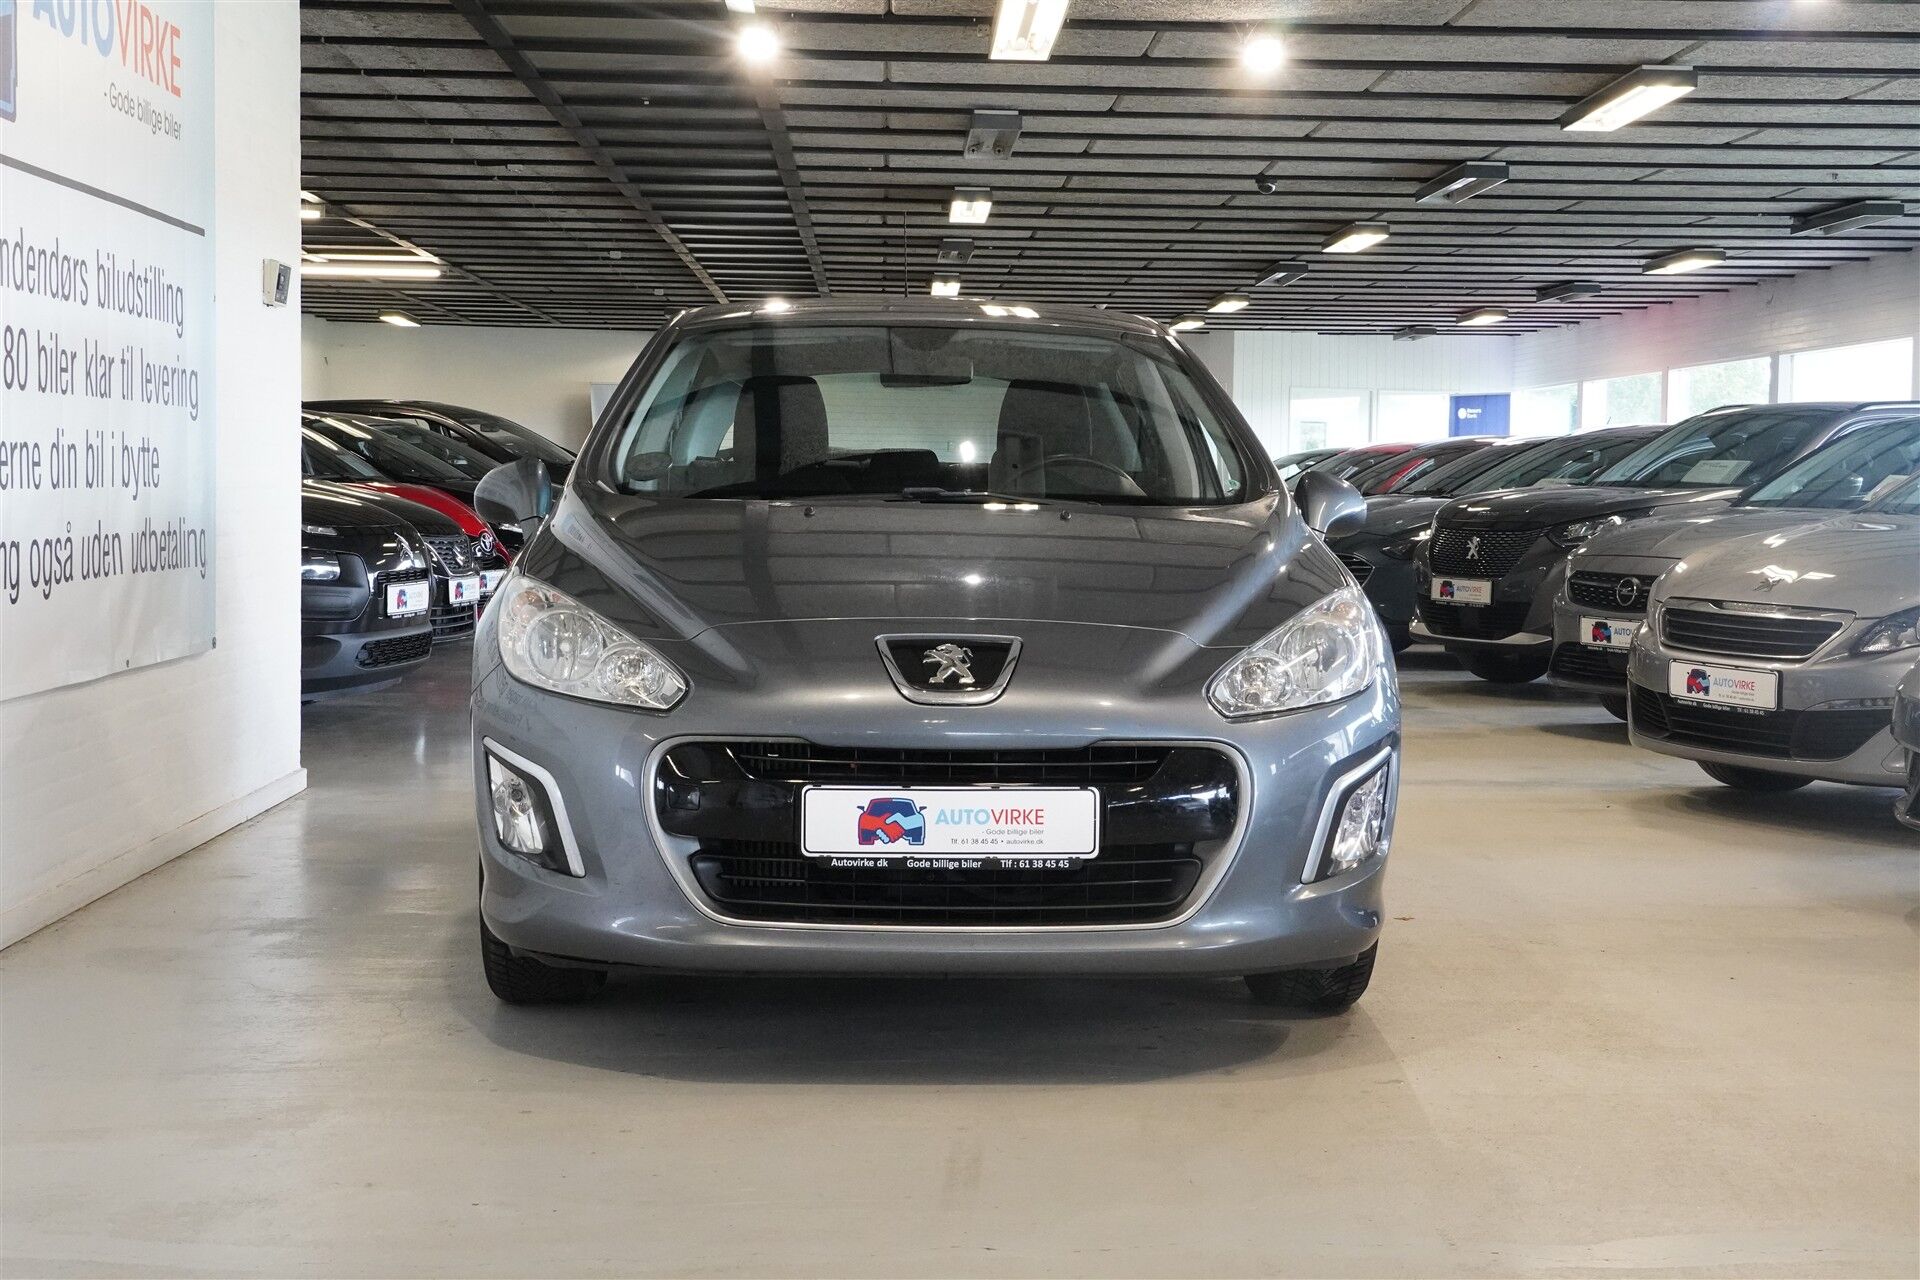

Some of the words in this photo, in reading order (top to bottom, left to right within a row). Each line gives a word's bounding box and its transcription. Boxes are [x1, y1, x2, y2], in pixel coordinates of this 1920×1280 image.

[33, 0, 181, 98] OVIRKE
[109, 82, 135, 118] Gode
[164, 110, 181, 141] biler
[0, 227, 89, 306] ndendørs
[96, 249, 183, 339] biludstilling
[3, 325, 28, 391] 80
[37, 329, 77, 396] biler
[85, 338, 115, 399] klar
[120, 345, 133, 401] til
[141, 347, 199, 421] levering
[0, 440, 41, 490] erne
[50, 427, 77, 490] din
[86, 429, 104, 489] bil
[111, 430, 115, 488] i
[122, 431, 160, 501] bytte
[30, 520, 73, 600] også
[81, 519, 123, 580] uden
[131, 516, 206, 580] udbetaling
[1613, 627, 1632, 636] AUTO
[1713, 677, 1756, 691] AUTOVIRKE
[935, 808, 1044, 825] AUTOVIRKE
[831, 858, 875, 867] Autovirke
[876, 858, 888, 867] dk
[907, 859, 931, 867] Gode
[932, 859, 960, 869] billige
[1019, 859, 1030, 868] 61
[1032, 859, 1043, 868] 38
[1045, 859, 1056, 868] 45
[1058, 859, 1070, 868] 45
